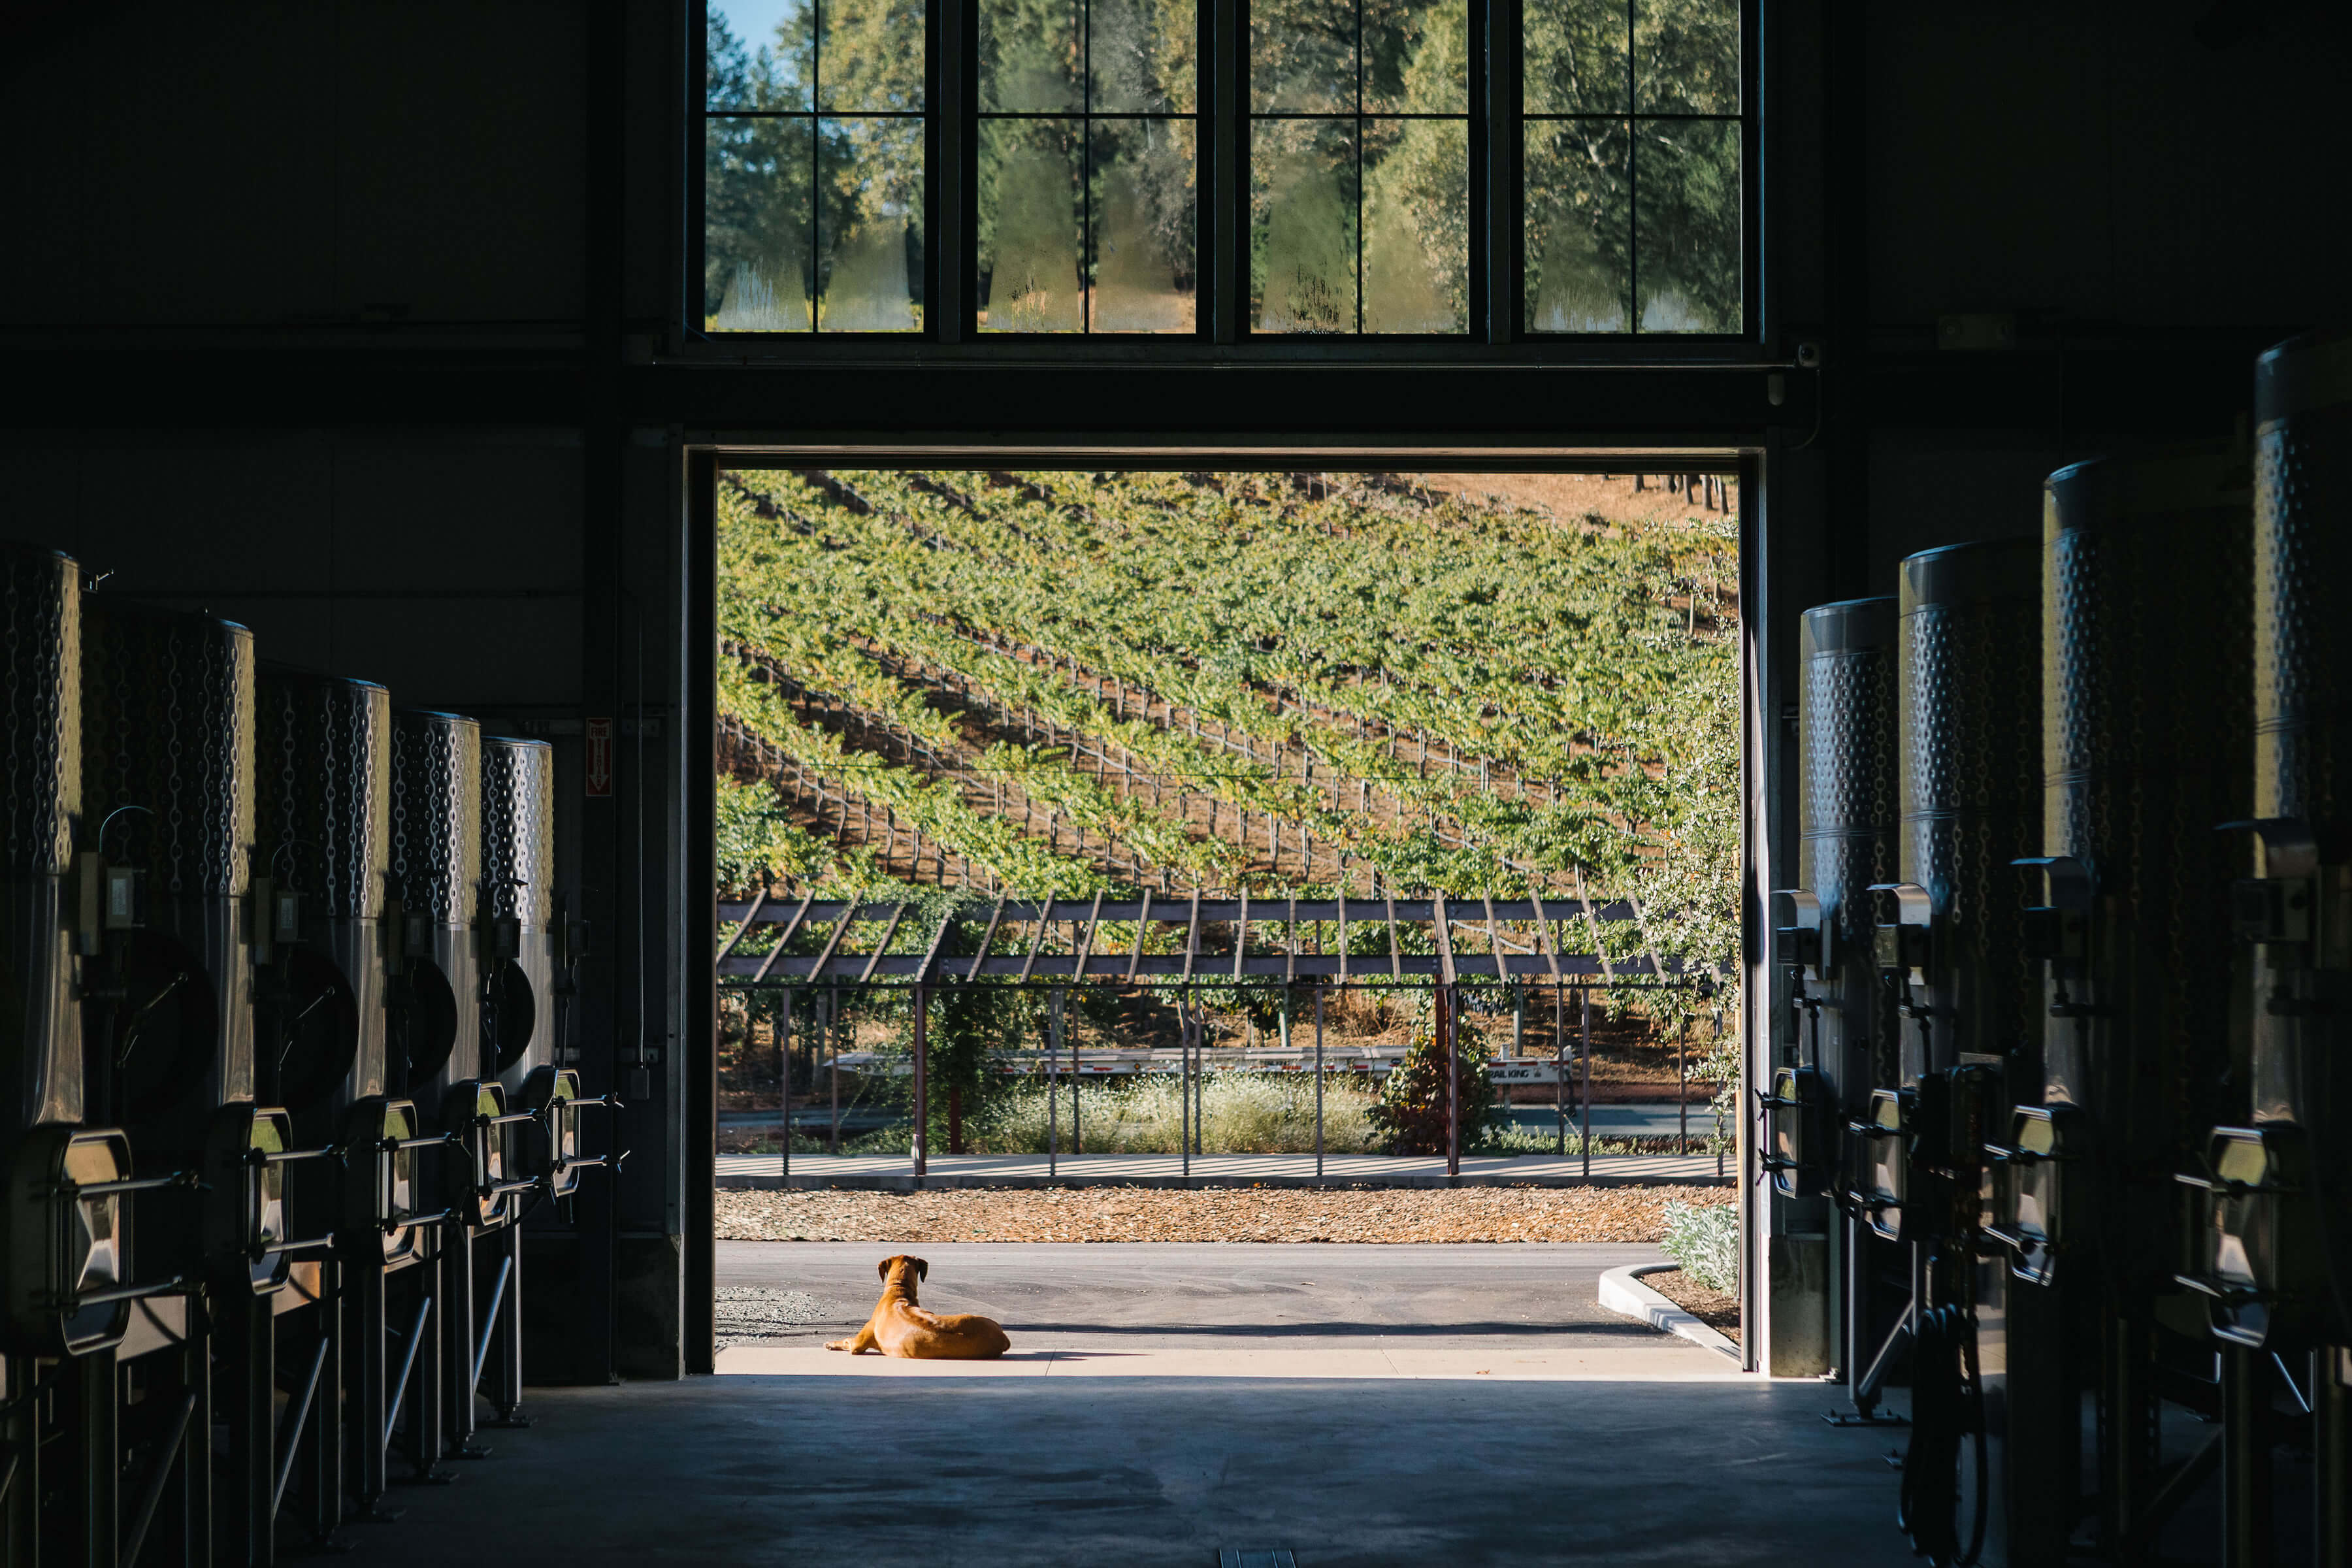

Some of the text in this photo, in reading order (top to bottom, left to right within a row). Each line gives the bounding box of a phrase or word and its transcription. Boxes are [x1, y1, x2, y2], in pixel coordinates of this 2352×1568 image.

[591, 727, 607, 737] FIRE
[1490, 1070, 1507, 1078] RAIL
[1508, 1069, 1529, 1078] KING
